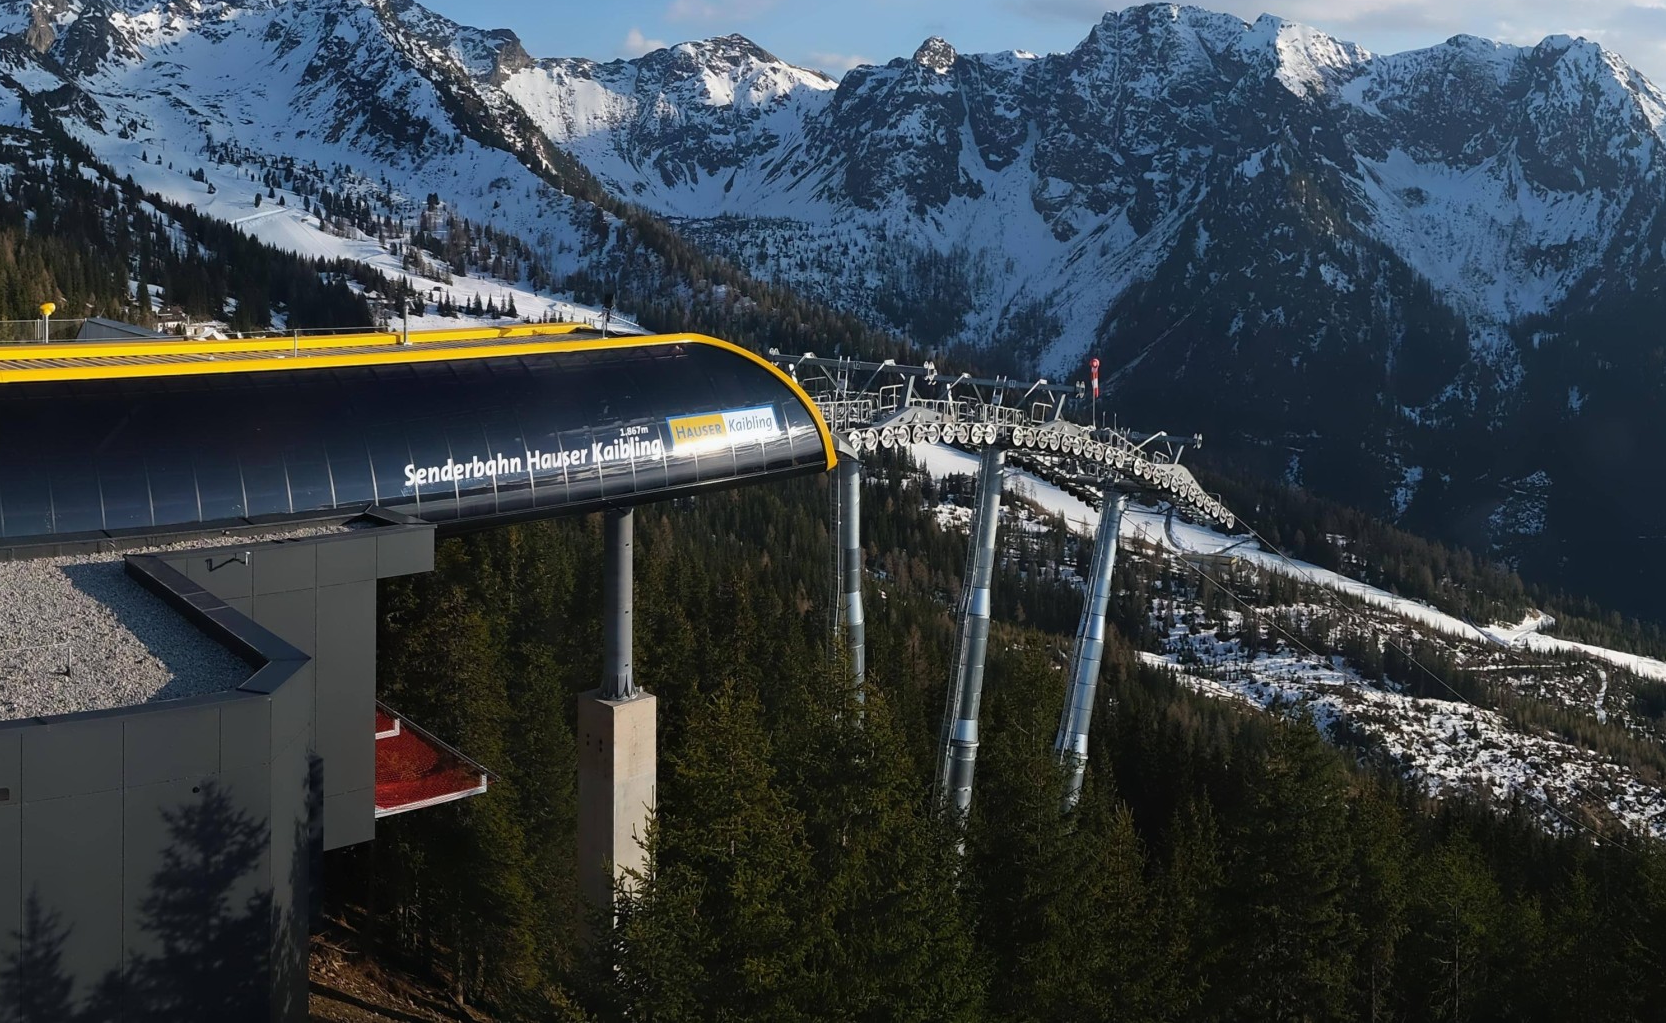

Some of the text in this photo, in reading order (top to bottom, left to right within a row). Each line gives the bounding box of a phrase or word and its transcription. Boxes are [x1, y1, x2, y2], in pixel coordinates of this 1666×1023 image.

[619, 425, 649, 437] 1.867m
[675, 415, 773, 440] HAUSER Kaibling
[404, 436, 663, 487] Senderbahn Hauser Kaibling
